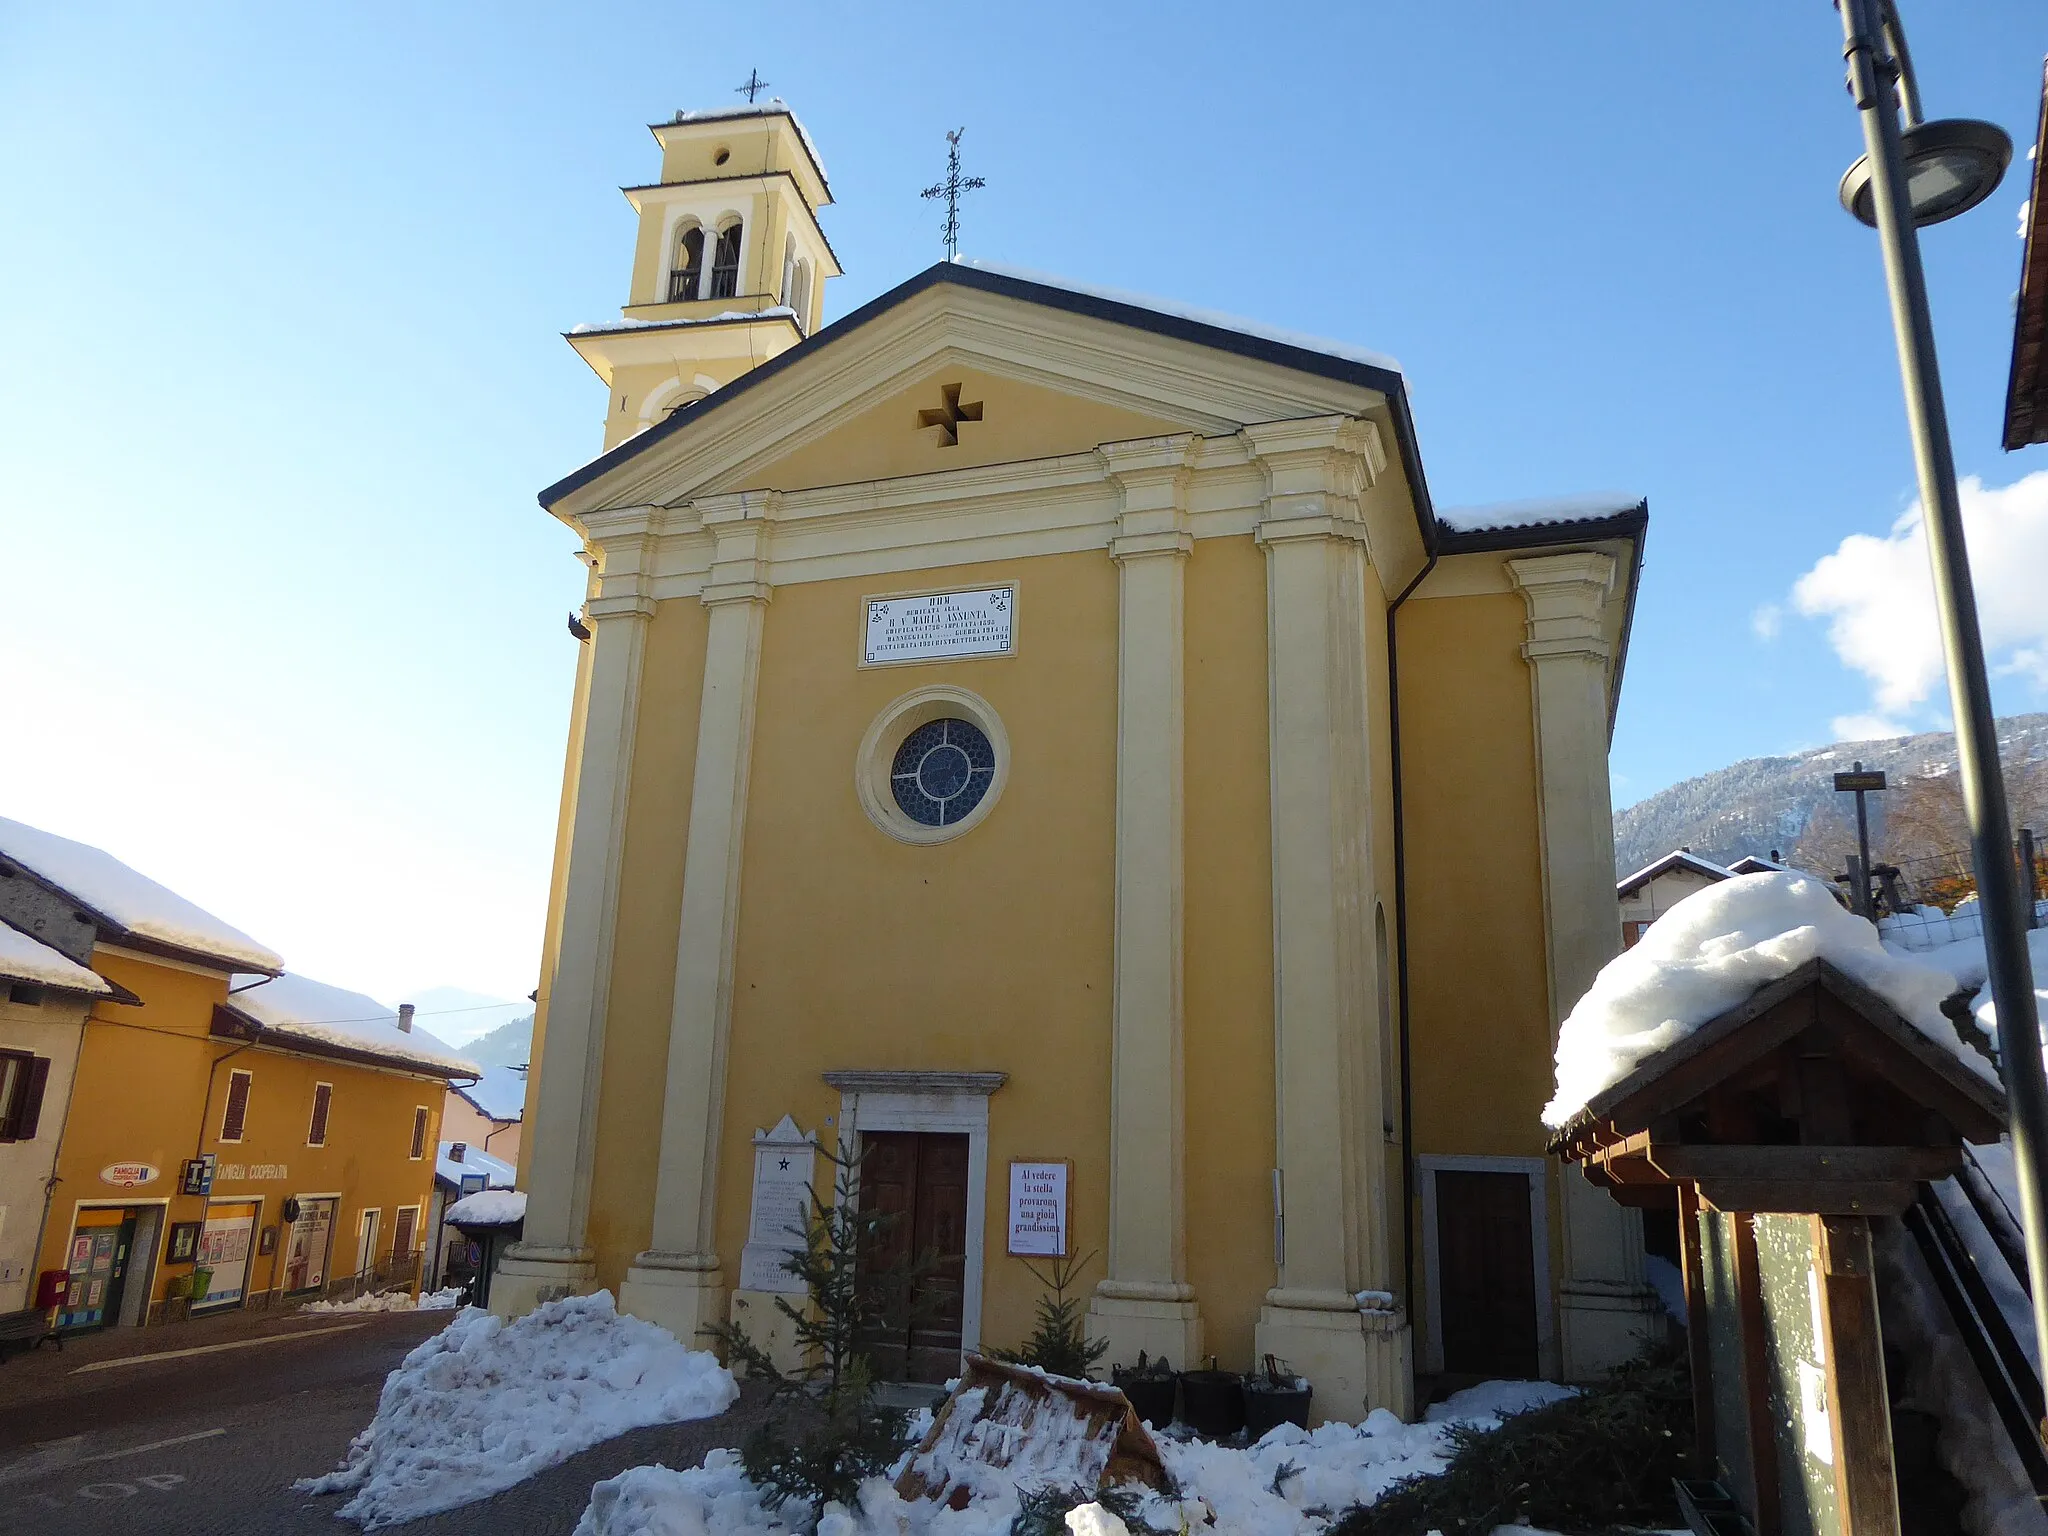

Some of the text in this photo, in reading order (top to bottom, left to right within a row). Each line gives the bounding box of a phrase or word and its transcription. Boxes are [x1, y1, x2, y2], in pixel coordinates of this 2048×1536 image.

[912, 614, 941, 625] MARIA
[947, 610, 987, 622] ASSUNTA
[113, 1166, 140, 1175] FAMIGLIA
[1021, 1170, 1057, 1180] Al vedere
[1024, 1182, 1053, 1193] la stella
[1019, 1198, 1057, 1208] provarono
[1020, 1208, 1055, 1222] una gioia
[1015, 1222, 1060, 1234] grandissima
